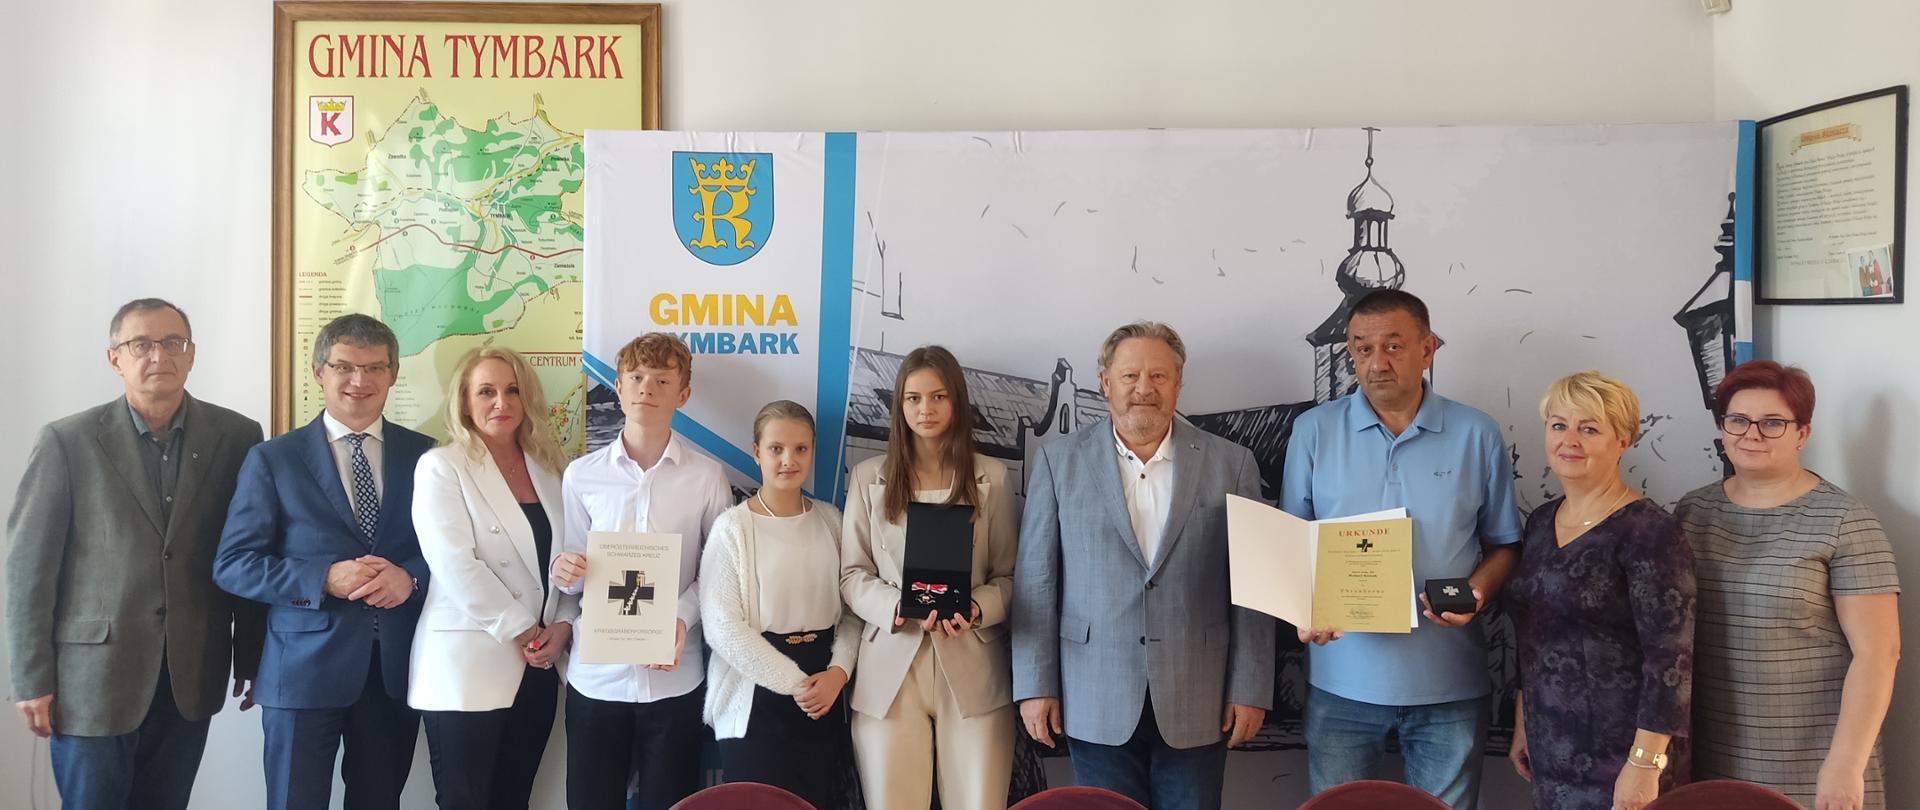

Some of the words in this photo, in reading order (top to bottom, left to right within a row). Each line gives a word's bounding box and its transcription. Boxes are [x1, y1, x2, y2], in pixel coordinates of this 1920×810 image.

[308, 34, 432, 79] GMINA
[444, 34, 623, 80] TYMBARK
[649, 293, 798, 327] GMINA
[667, 332, 800, 355] MBARK
[530, 355, 577, 367] CENTRUM
[1339, 528, 1391, 537] URKUNDE
